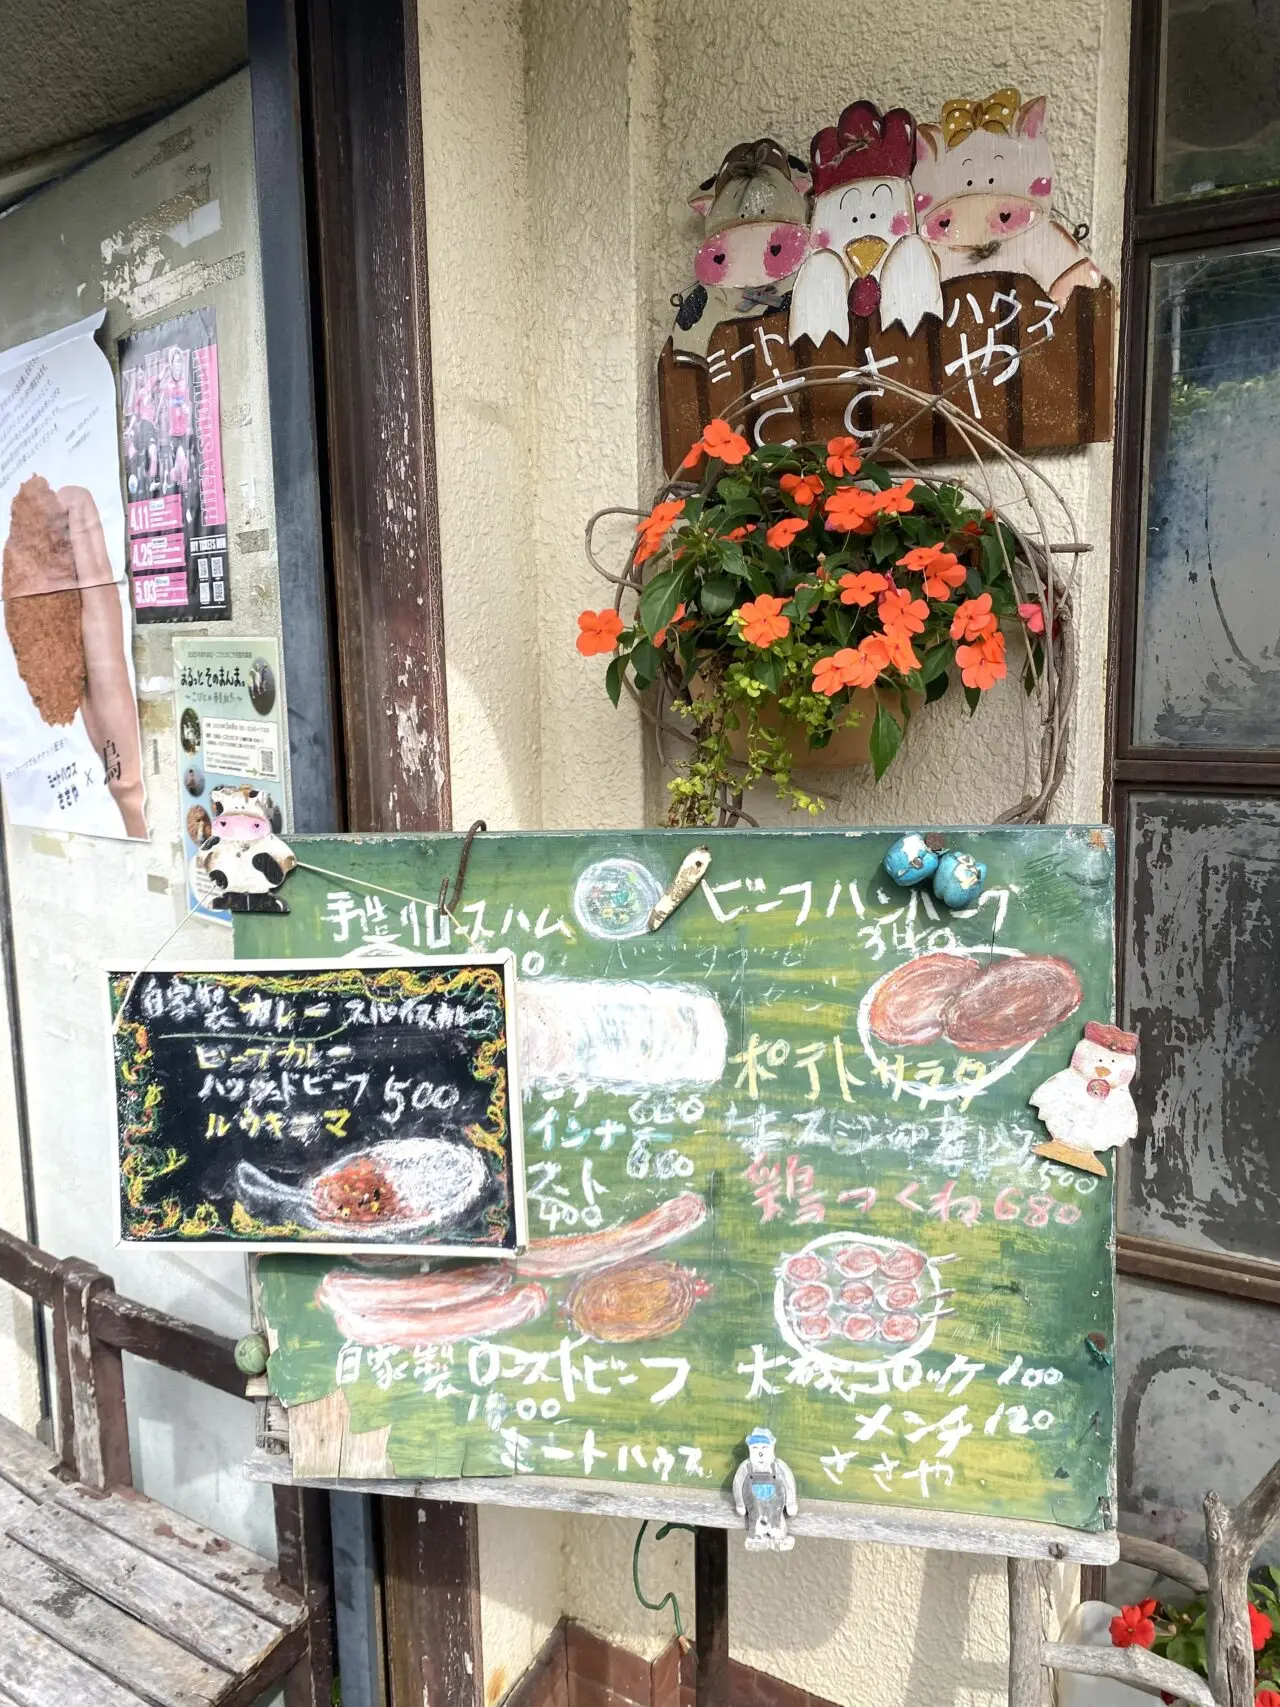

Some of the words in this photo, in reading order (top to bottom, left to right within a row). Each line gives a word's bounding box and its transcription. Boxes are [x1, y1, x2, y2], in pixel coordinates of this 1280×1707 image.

[706, 326, 785, 383] ミート
[946, 288, 1059, 340] ハウス
[993, 1186, 1082, 1229] 680
[997, 1354, 1064, 1389] 100
[852, 1403, 973, 1459] メンチ
[983, 1402, 1056, 1437] 120
[819, 1445, 955, 1499] ささや
